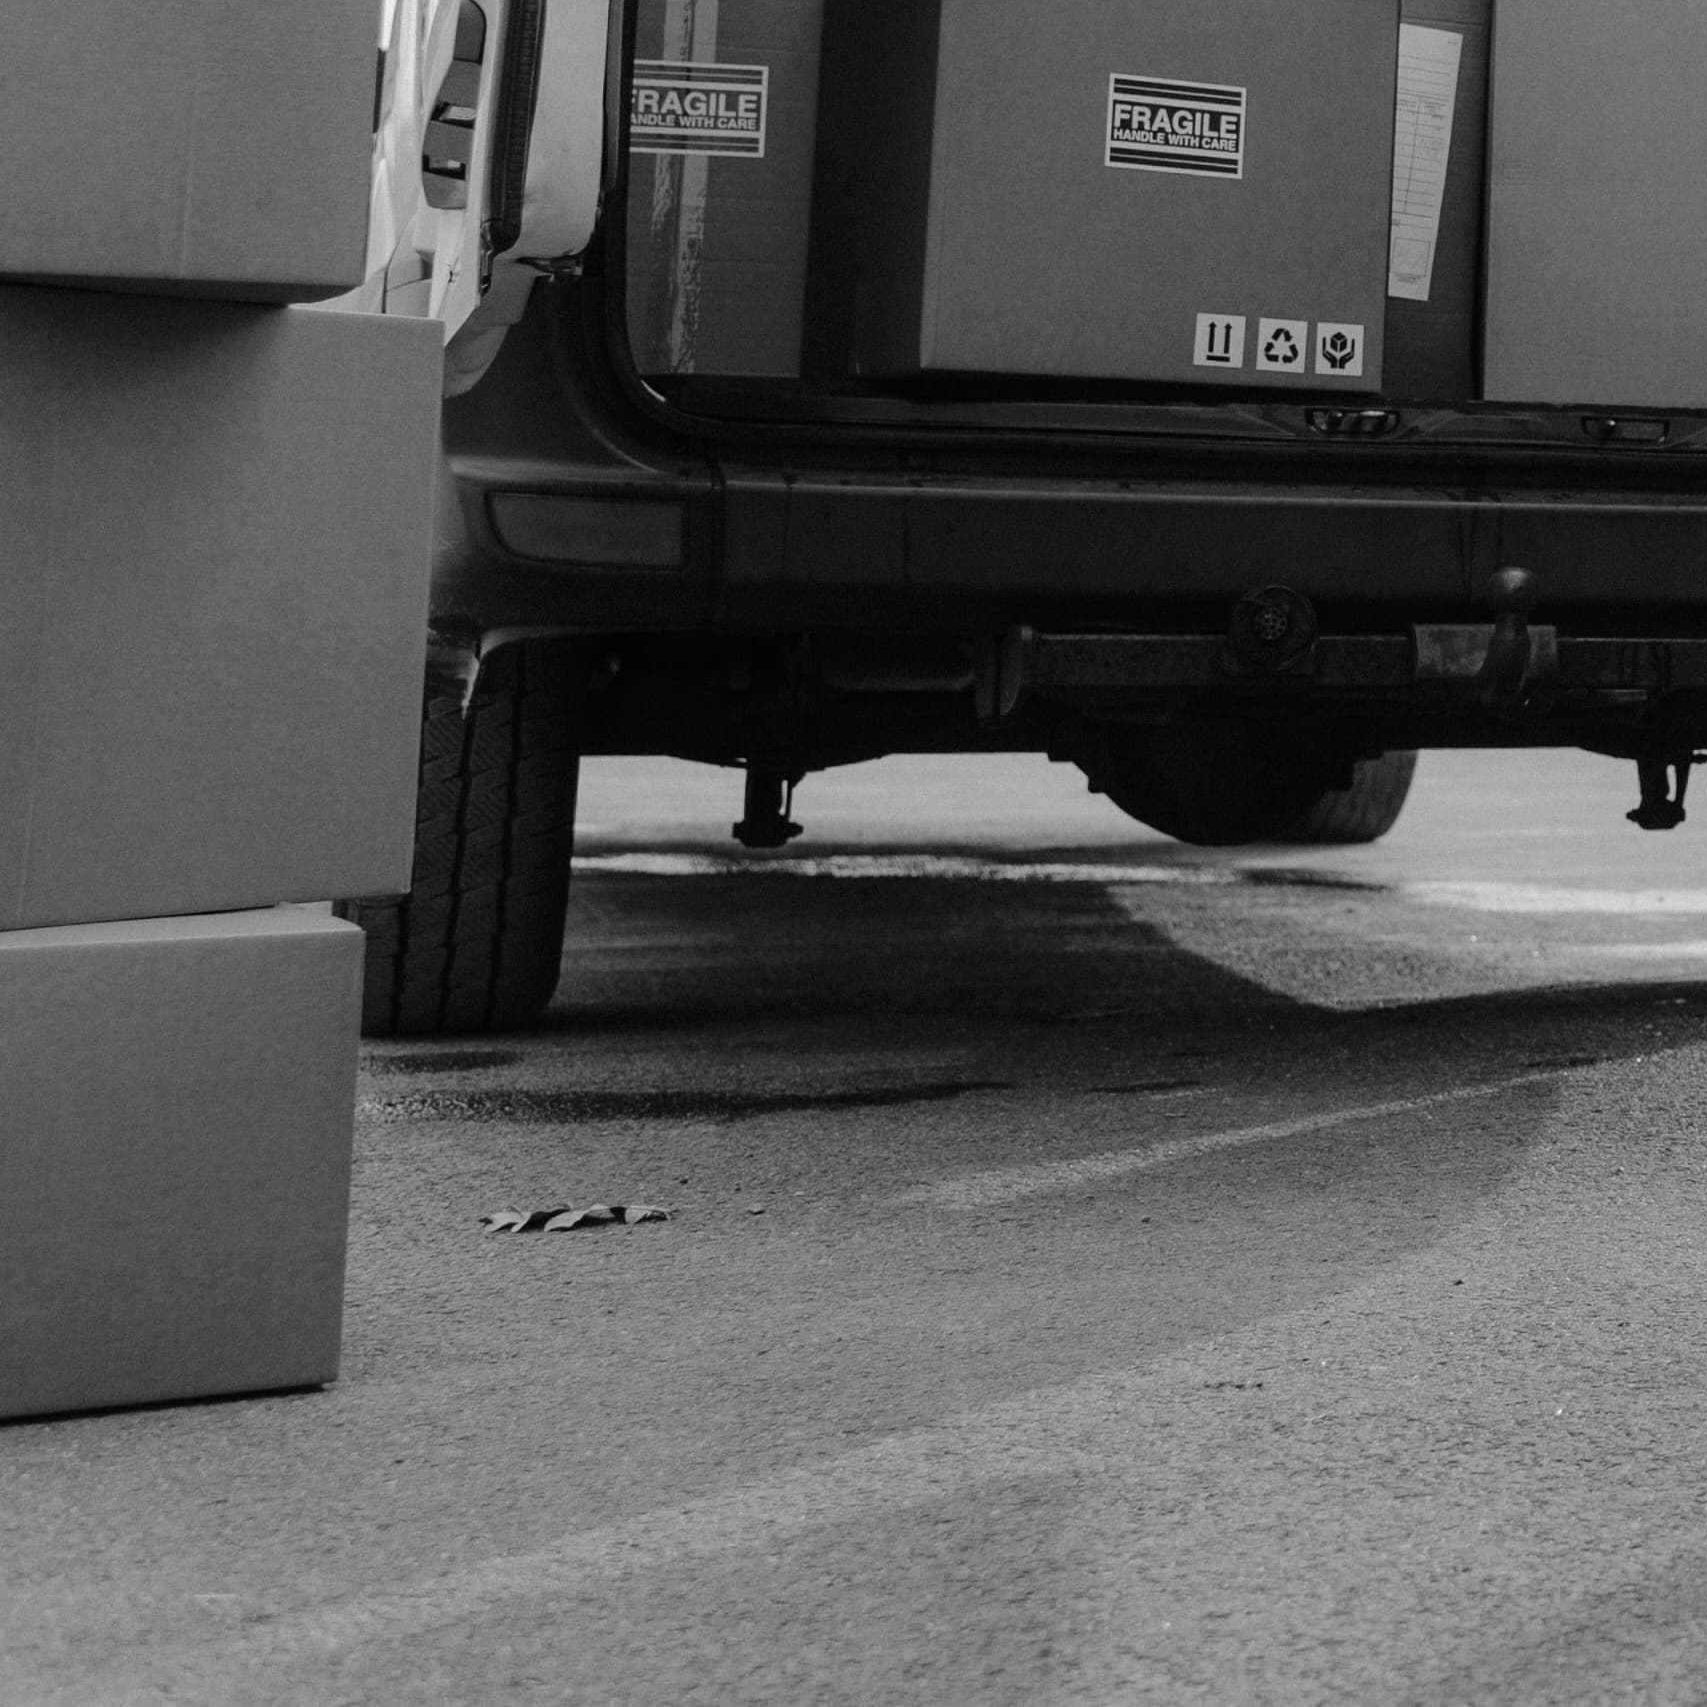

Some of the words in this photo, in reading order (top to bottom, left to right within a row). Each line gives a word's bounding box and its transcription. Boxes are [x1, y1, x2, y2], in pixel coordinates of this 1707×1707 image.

[632, 89, 758, 118] RAGILE
[631, 114, 675, 126] ANDLE
[679, 116, 714, 128] WITH
[717, 118, 757, 130] CARE
[1114, 103, 1238, 140] FRAGILE
[1113, 128, 1165, 144] HANDLE
[1168, 134, 1199, 147] WITH
[1202, 138, 1236, 151] CARE
